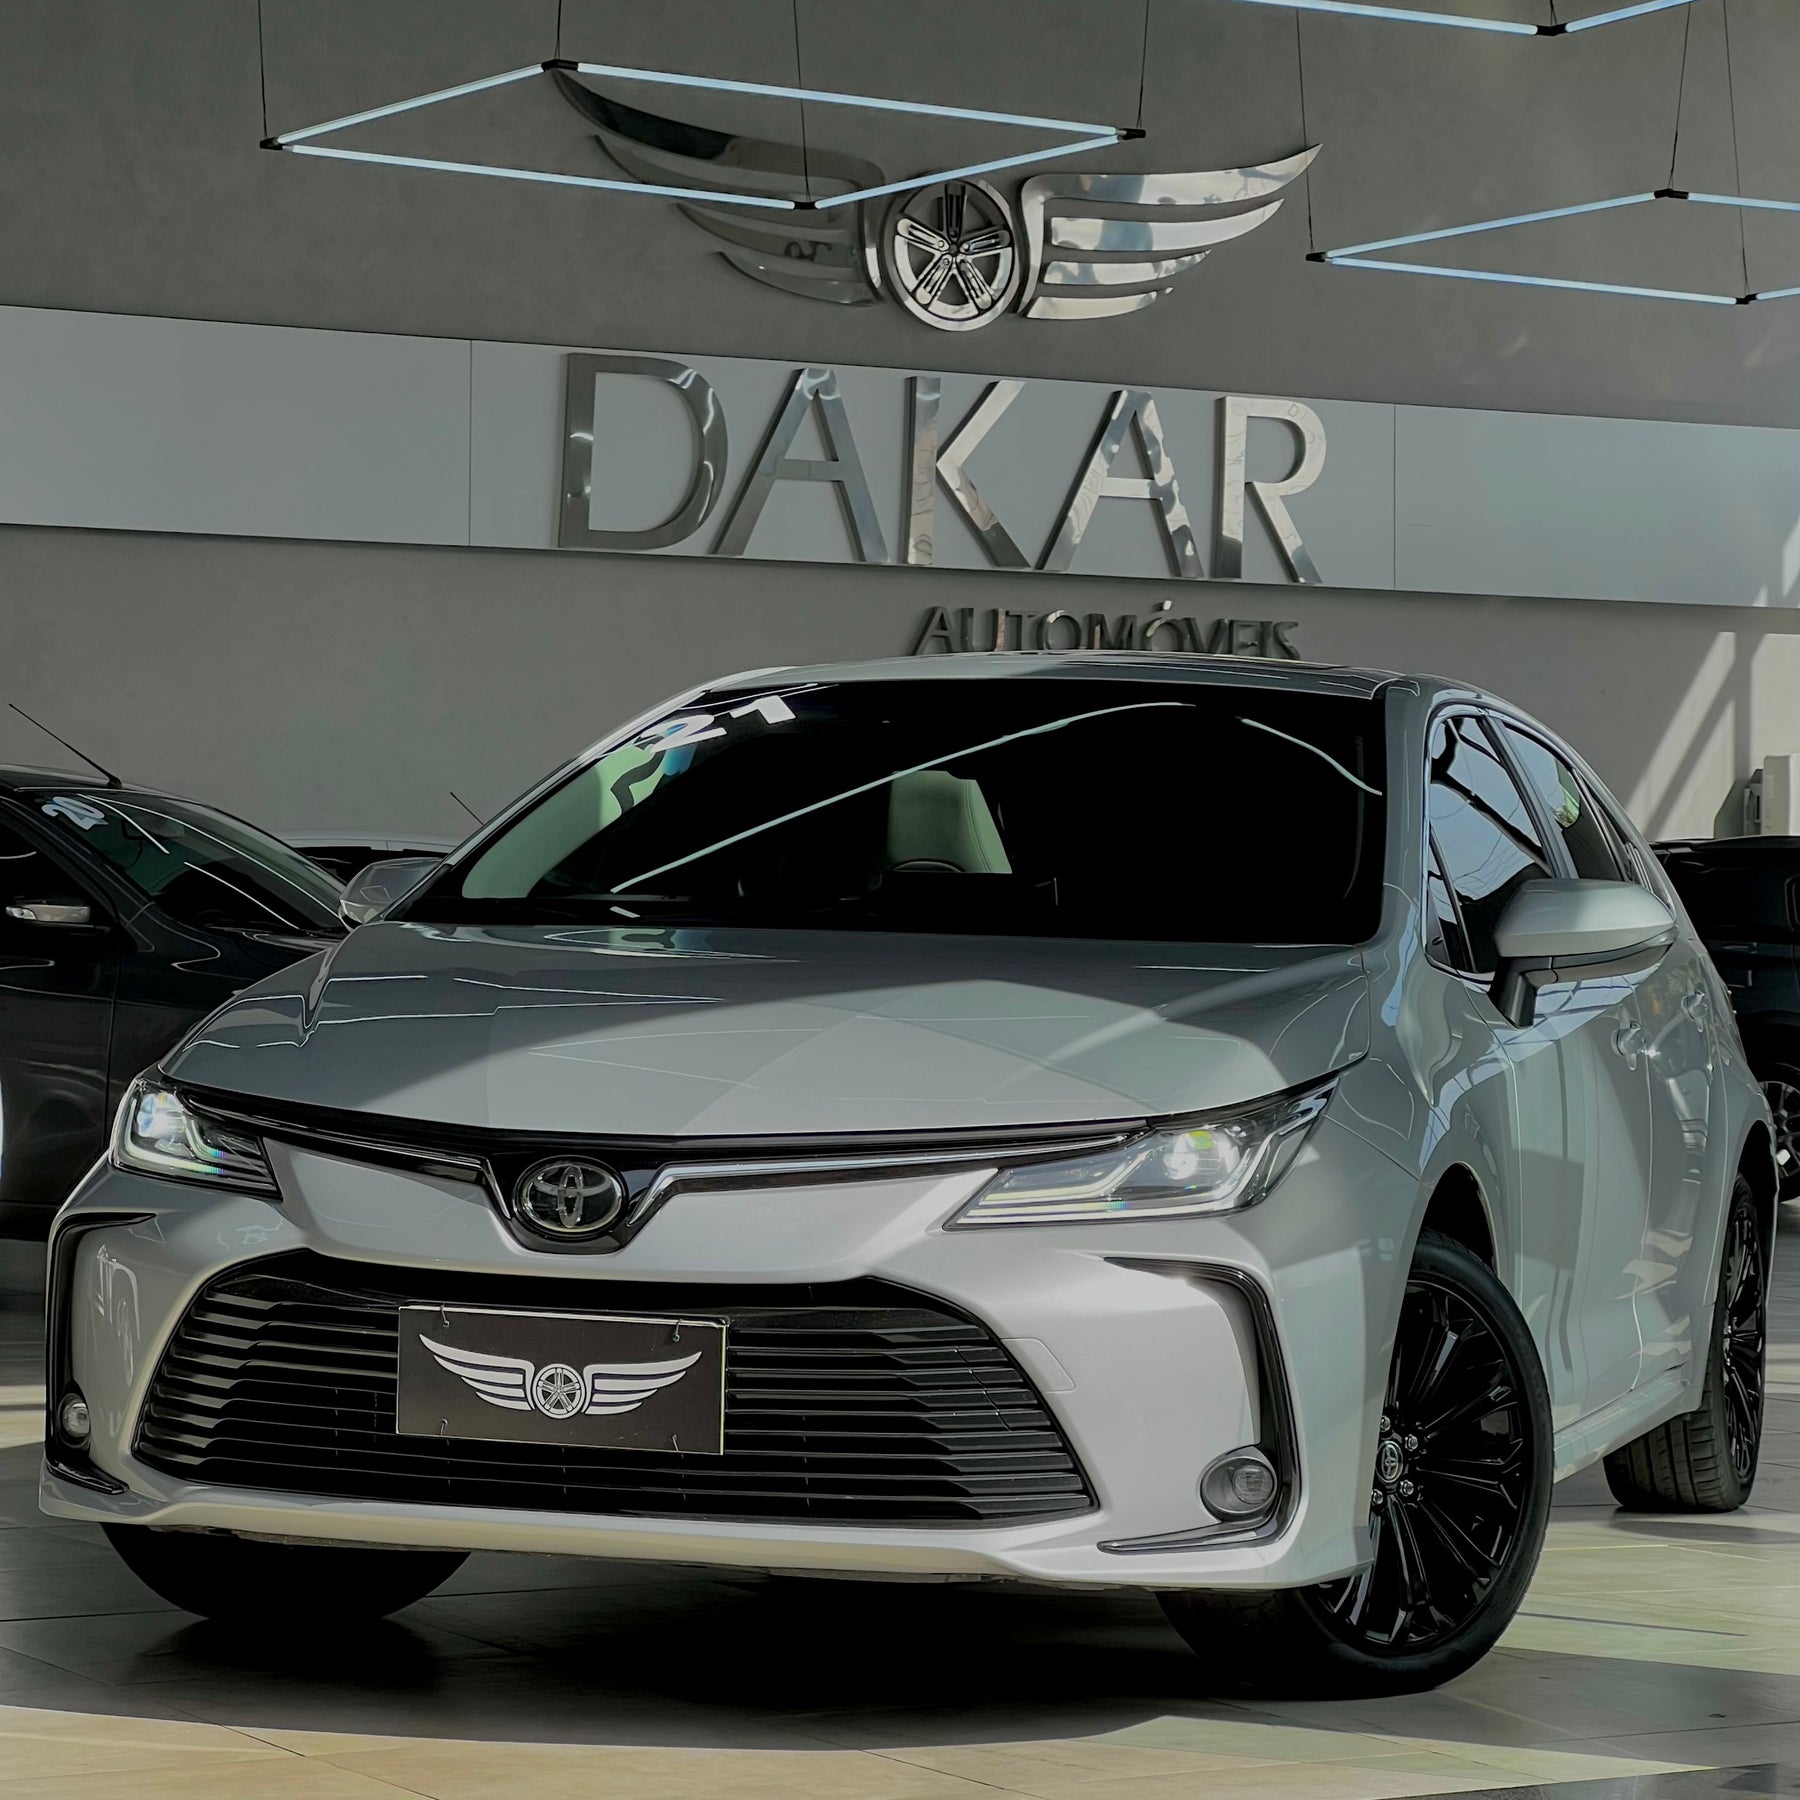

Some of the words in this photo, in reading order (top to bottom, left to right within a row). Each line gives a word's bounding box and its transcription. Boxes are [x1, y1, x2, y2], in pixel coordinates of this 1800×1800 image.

[558, 352, 1327, 585] DAKAR
[912, 600, 1300, 660] AUTOMÓVEIS
[638, 695, 796, 752] 21
